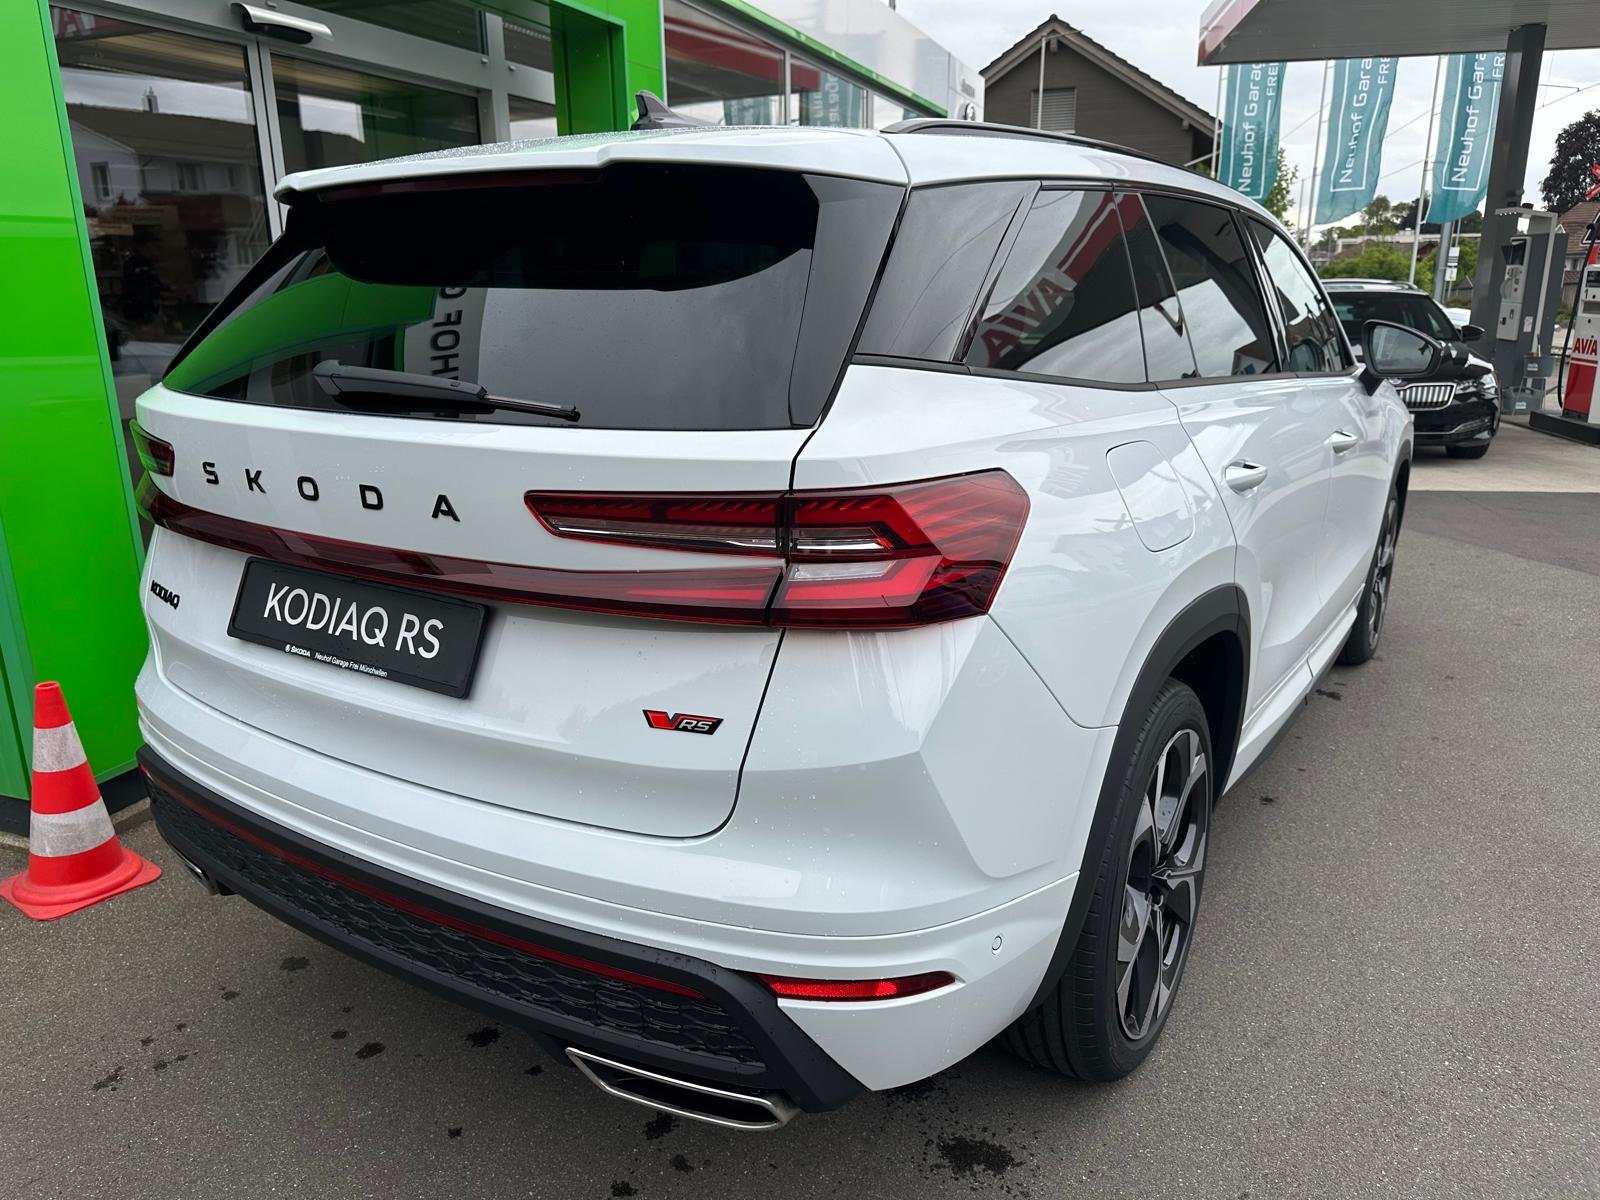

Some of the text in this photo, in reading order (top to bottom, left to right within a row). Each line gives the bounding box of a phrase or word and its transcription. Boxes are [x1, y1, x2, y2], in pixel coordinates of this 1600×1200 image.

[1378, 57, 1391, 84] FRE
[1492, 54, 1505, 78] FR
[1340, 57, 1373, 184] Neuhof Gara
[1450, 53, 1487, 182] Neuhof Gara
[1238, 121, 1256, 192] Neuhof
[1573, 337, 1598, 356] AVIA
[150, 579, 181, 610] KODIAQ
[263, 582, 444, 659] KODIAQ RS
[314, 652, 332, 663] Neuhof
[331, 656, 349, 669] Garage
[348, 661, 359, 670] Frei
